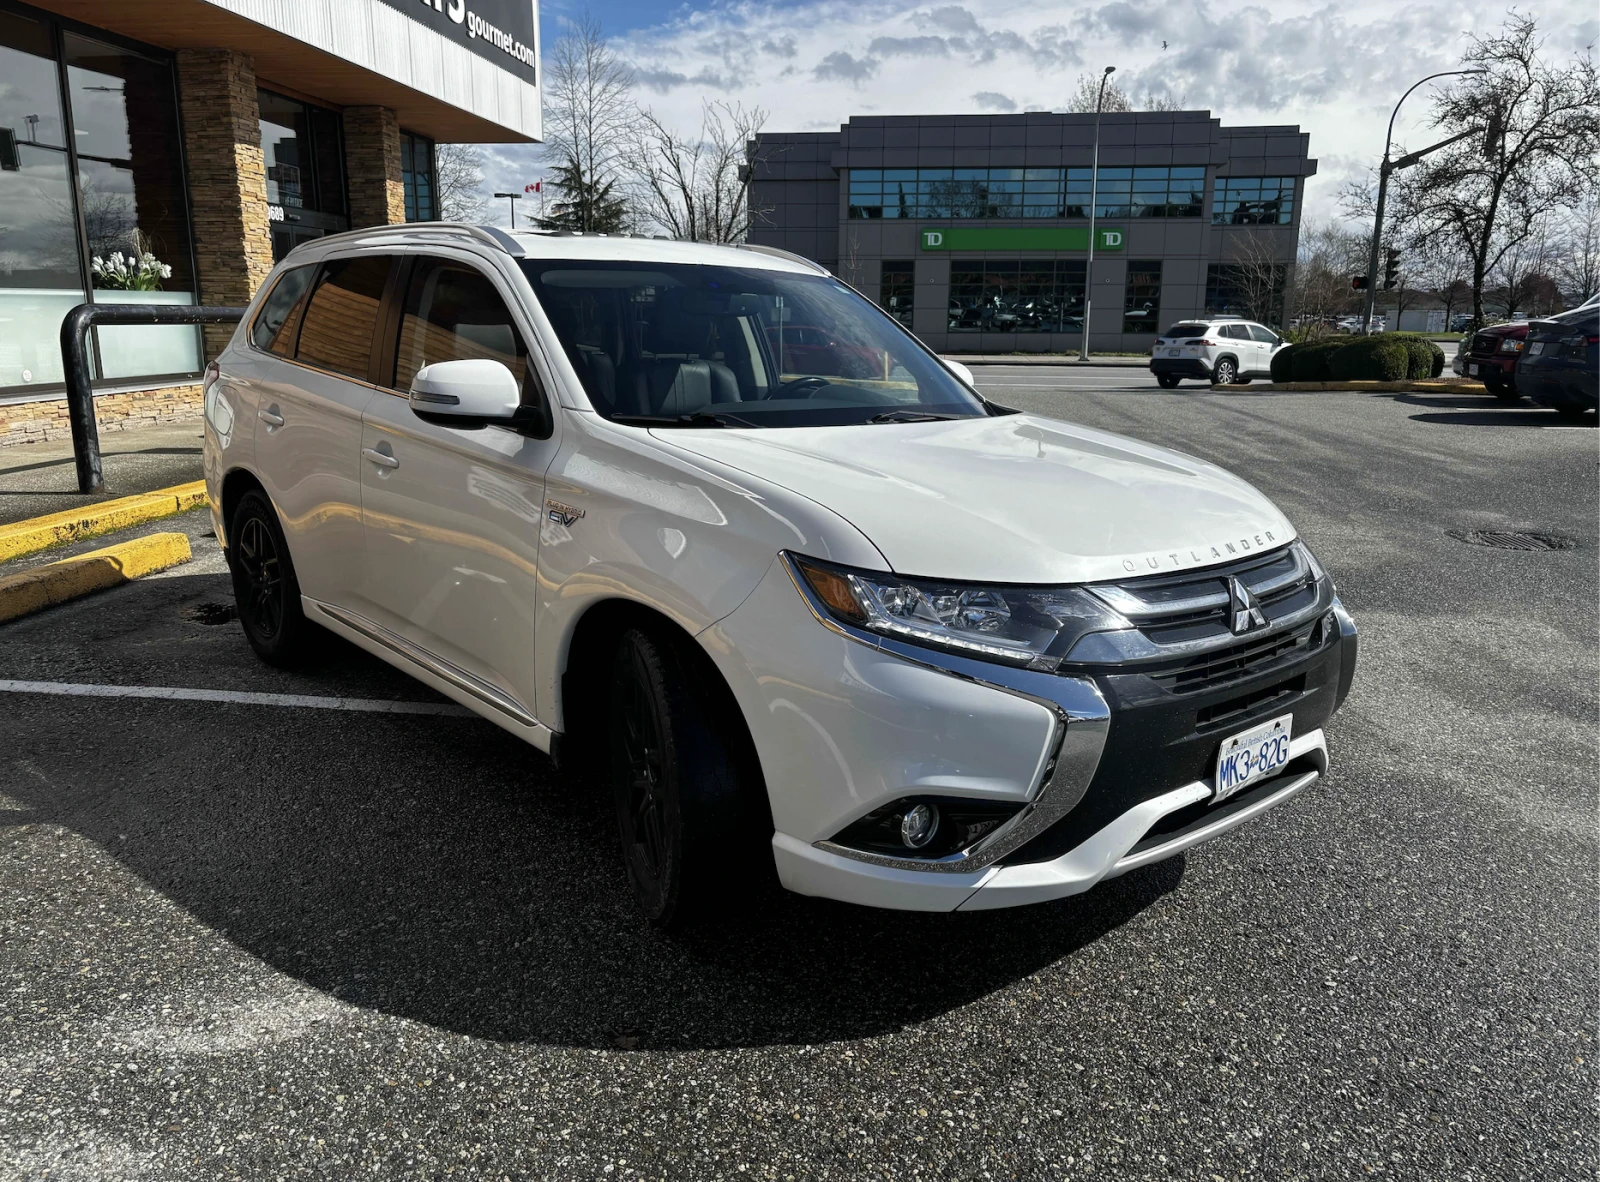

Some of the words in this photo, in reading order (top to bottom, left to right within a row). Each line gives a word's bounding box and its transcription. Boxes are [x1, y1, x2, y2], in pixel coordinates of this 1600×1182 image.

[467, 11, 535, 68] gourmet.com
[924, 232, 943, 246] TD
[1103, 232, 1122, 246] TD
[1122, 531, 1276, 572] OUTLANDER
[1247, 734, 1263, 748] British
[1220, 750, 1251, 791] MK3
[1258, 734, 1288, 772] 82G
